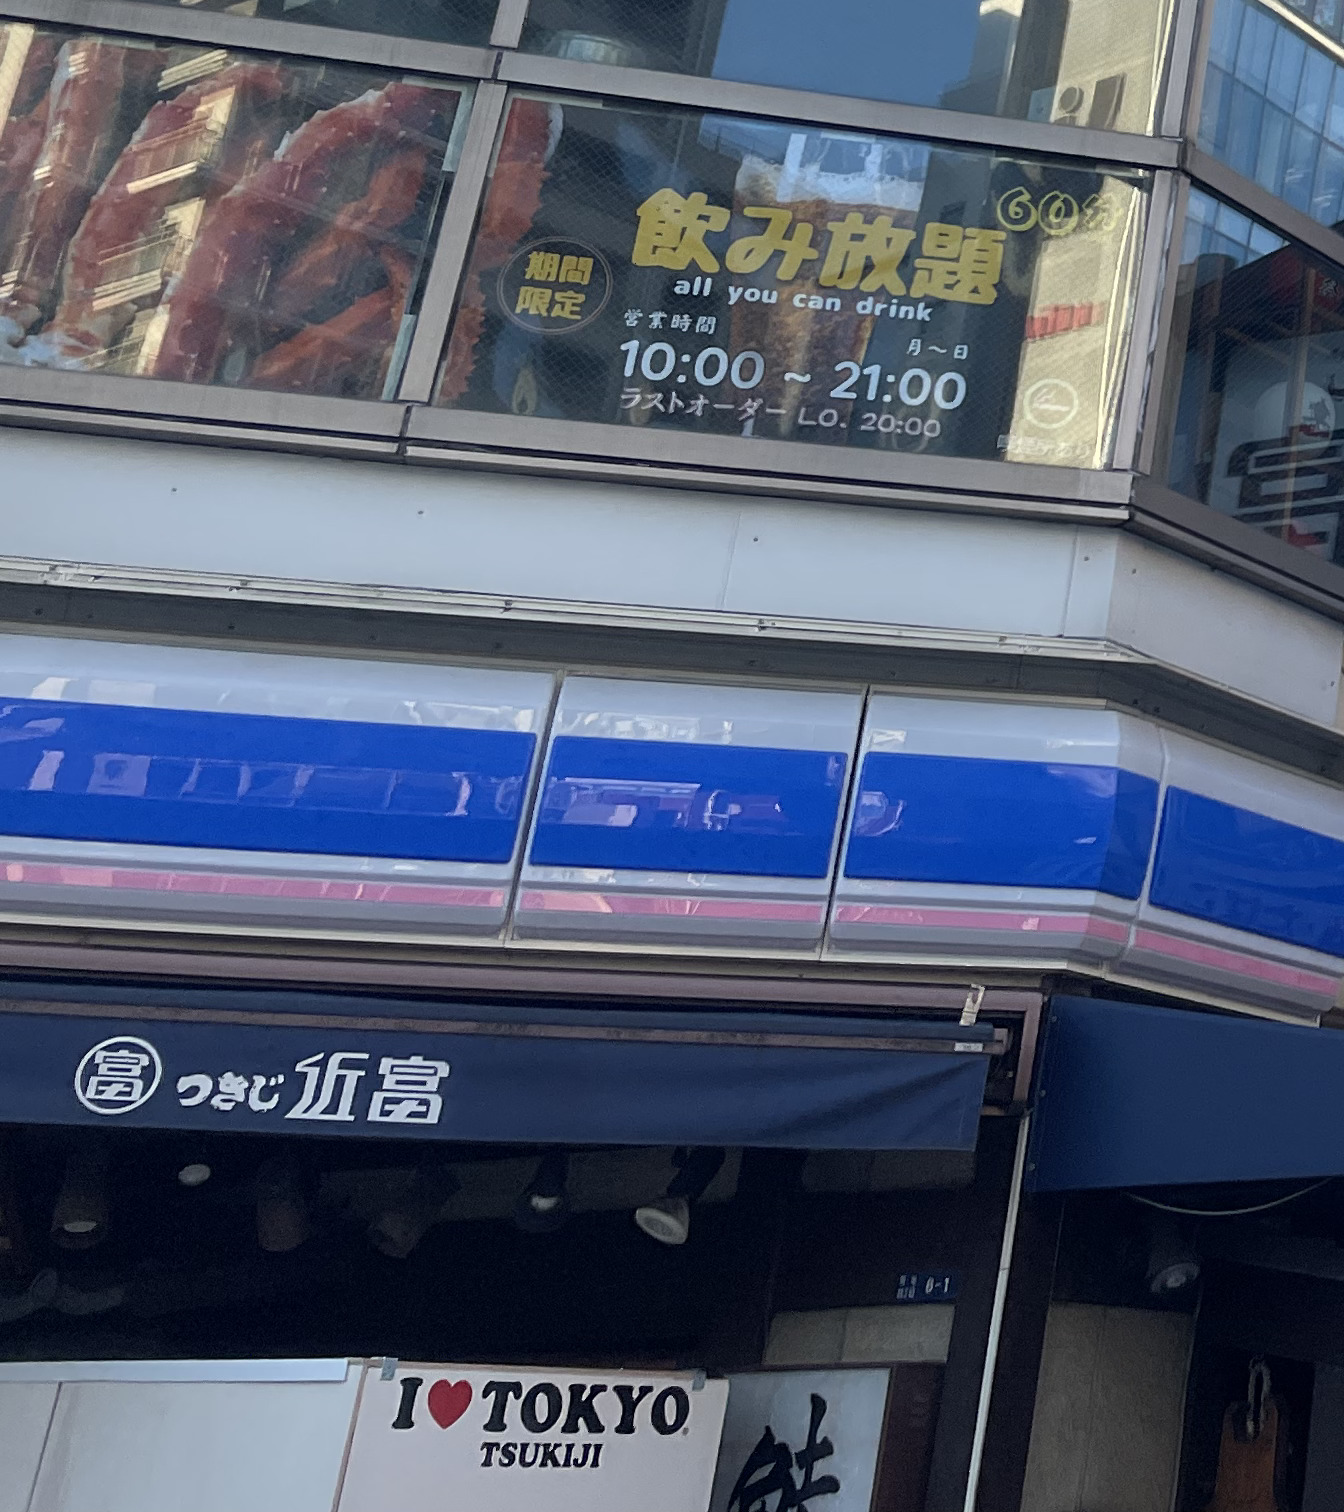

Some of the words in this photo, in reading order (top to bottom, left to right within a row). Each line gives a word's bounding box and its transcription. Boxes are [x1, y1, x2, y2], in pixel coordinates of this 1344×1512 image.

[524, 250, 595, 286] 期間
[632, 187, 1008, 306] 飲み放題
[514, 285, 586, 321] 限定
[622, 308, 718, 336] 営業時間
[673, 276, 711, 298] all
[727, 283, 779, 307] you
[792, 290, 842, 312] can
[856, 294, 934, 324] drink
[619, 339, 766, 390] 10:00
[829, 360, 968, 411] 21:00
[619, 386, 788, 424] ラストオーダー
[860, 413, 942, 439] 20:00
[176, 1072, 285, 1114] つきじ
[284, 1050, 450, 1125] 近富
[391, 1377, 425, 1430] I
[481, 1379, 691, 1435] TOKYO
[480, 1441, 604, 1469] TSUKIJI
